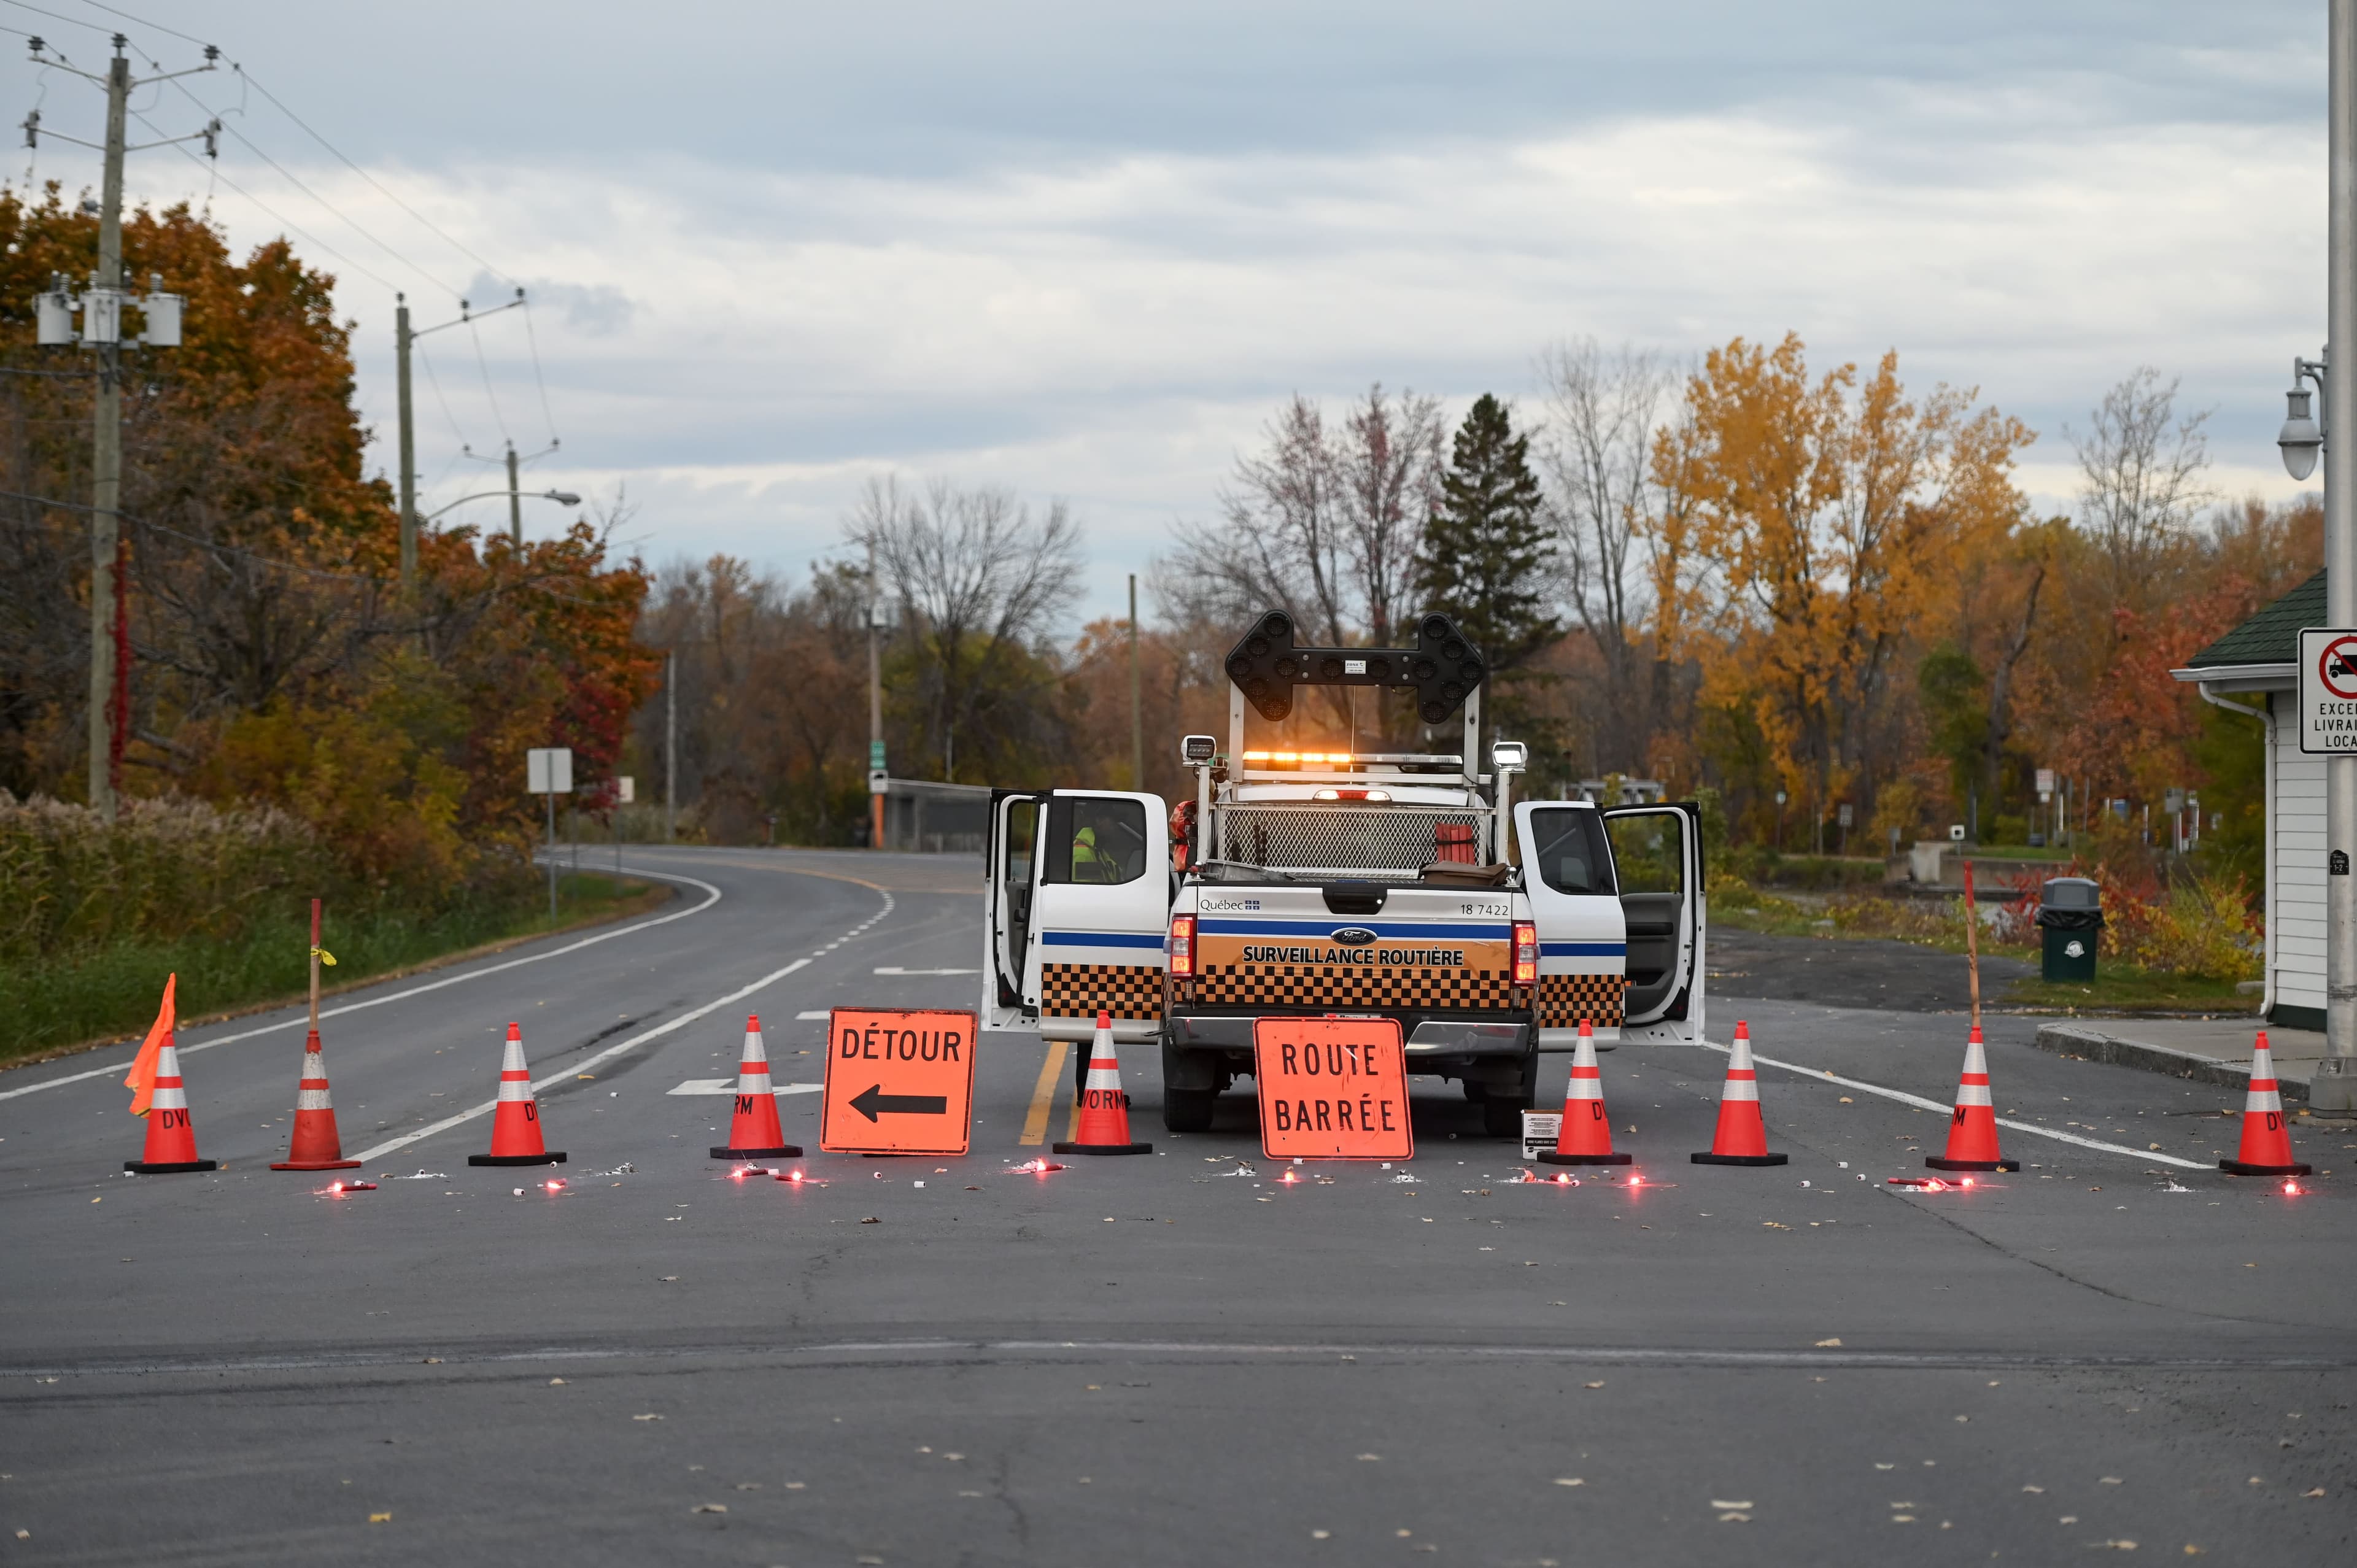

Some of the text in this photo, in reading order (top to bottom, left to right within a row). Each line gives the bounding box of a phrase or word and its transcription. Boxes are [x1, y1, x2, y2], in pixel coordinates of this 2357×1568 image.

[2320, 703, 2357, 715] EXCE
[1201, 899, 1243, 911] Québec
[1461, 905, 1508, 916] 18 7422
[1342, 931, 1367, 942] Ford
[1243, 946, 1463, 965] SURVEILLANCE ROUTIÈRE
[842, 1022, 961, 1062] DÉTOUR
[1282, 1043, 1379, 1075] ROUTE
[1275, 1094, 1396, 1131] BARRÉE
